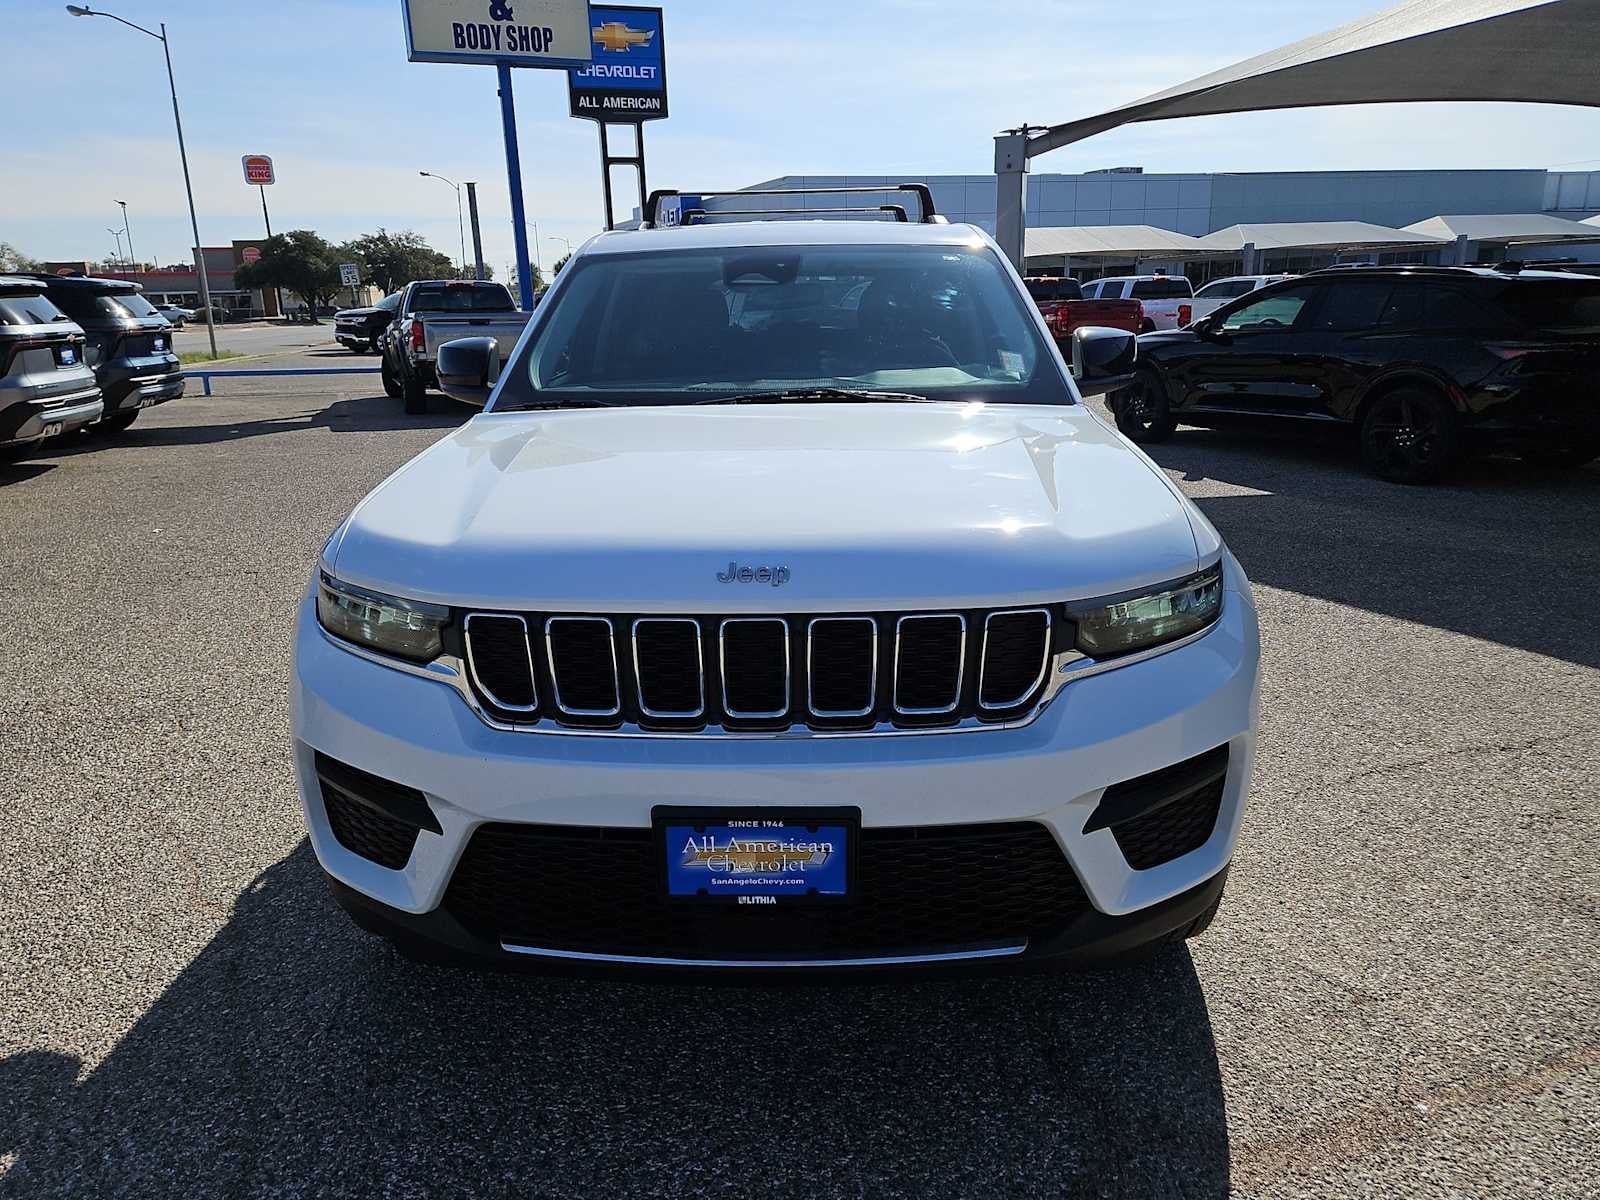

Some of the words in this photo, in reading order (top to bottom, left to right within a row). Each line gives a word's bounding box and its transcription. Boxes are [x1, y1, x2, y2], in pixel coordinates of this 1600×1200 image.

[489, 0, 514, 21] &
[452, 23, 501, 51] BODY
[506, 25, 553, 53] SHOP
[578, 96, 600, 108] ALL
[602, 97, 660, 109] AMERICAN
[344, 275, 358, 284] 35
[716, 560, 791, 587] Jeep
[728, 820, 759, 828] SINCE
[762, 820, 784, 828] 1946
[682, 836, 716, 853] All
[725, 837, 834, 853] American
[706, 854, 806, 873] Chevrolet
[711, 878, 805, 886] SanAngeloChevy.com
[746, 896, 777, 904] LITHIA
